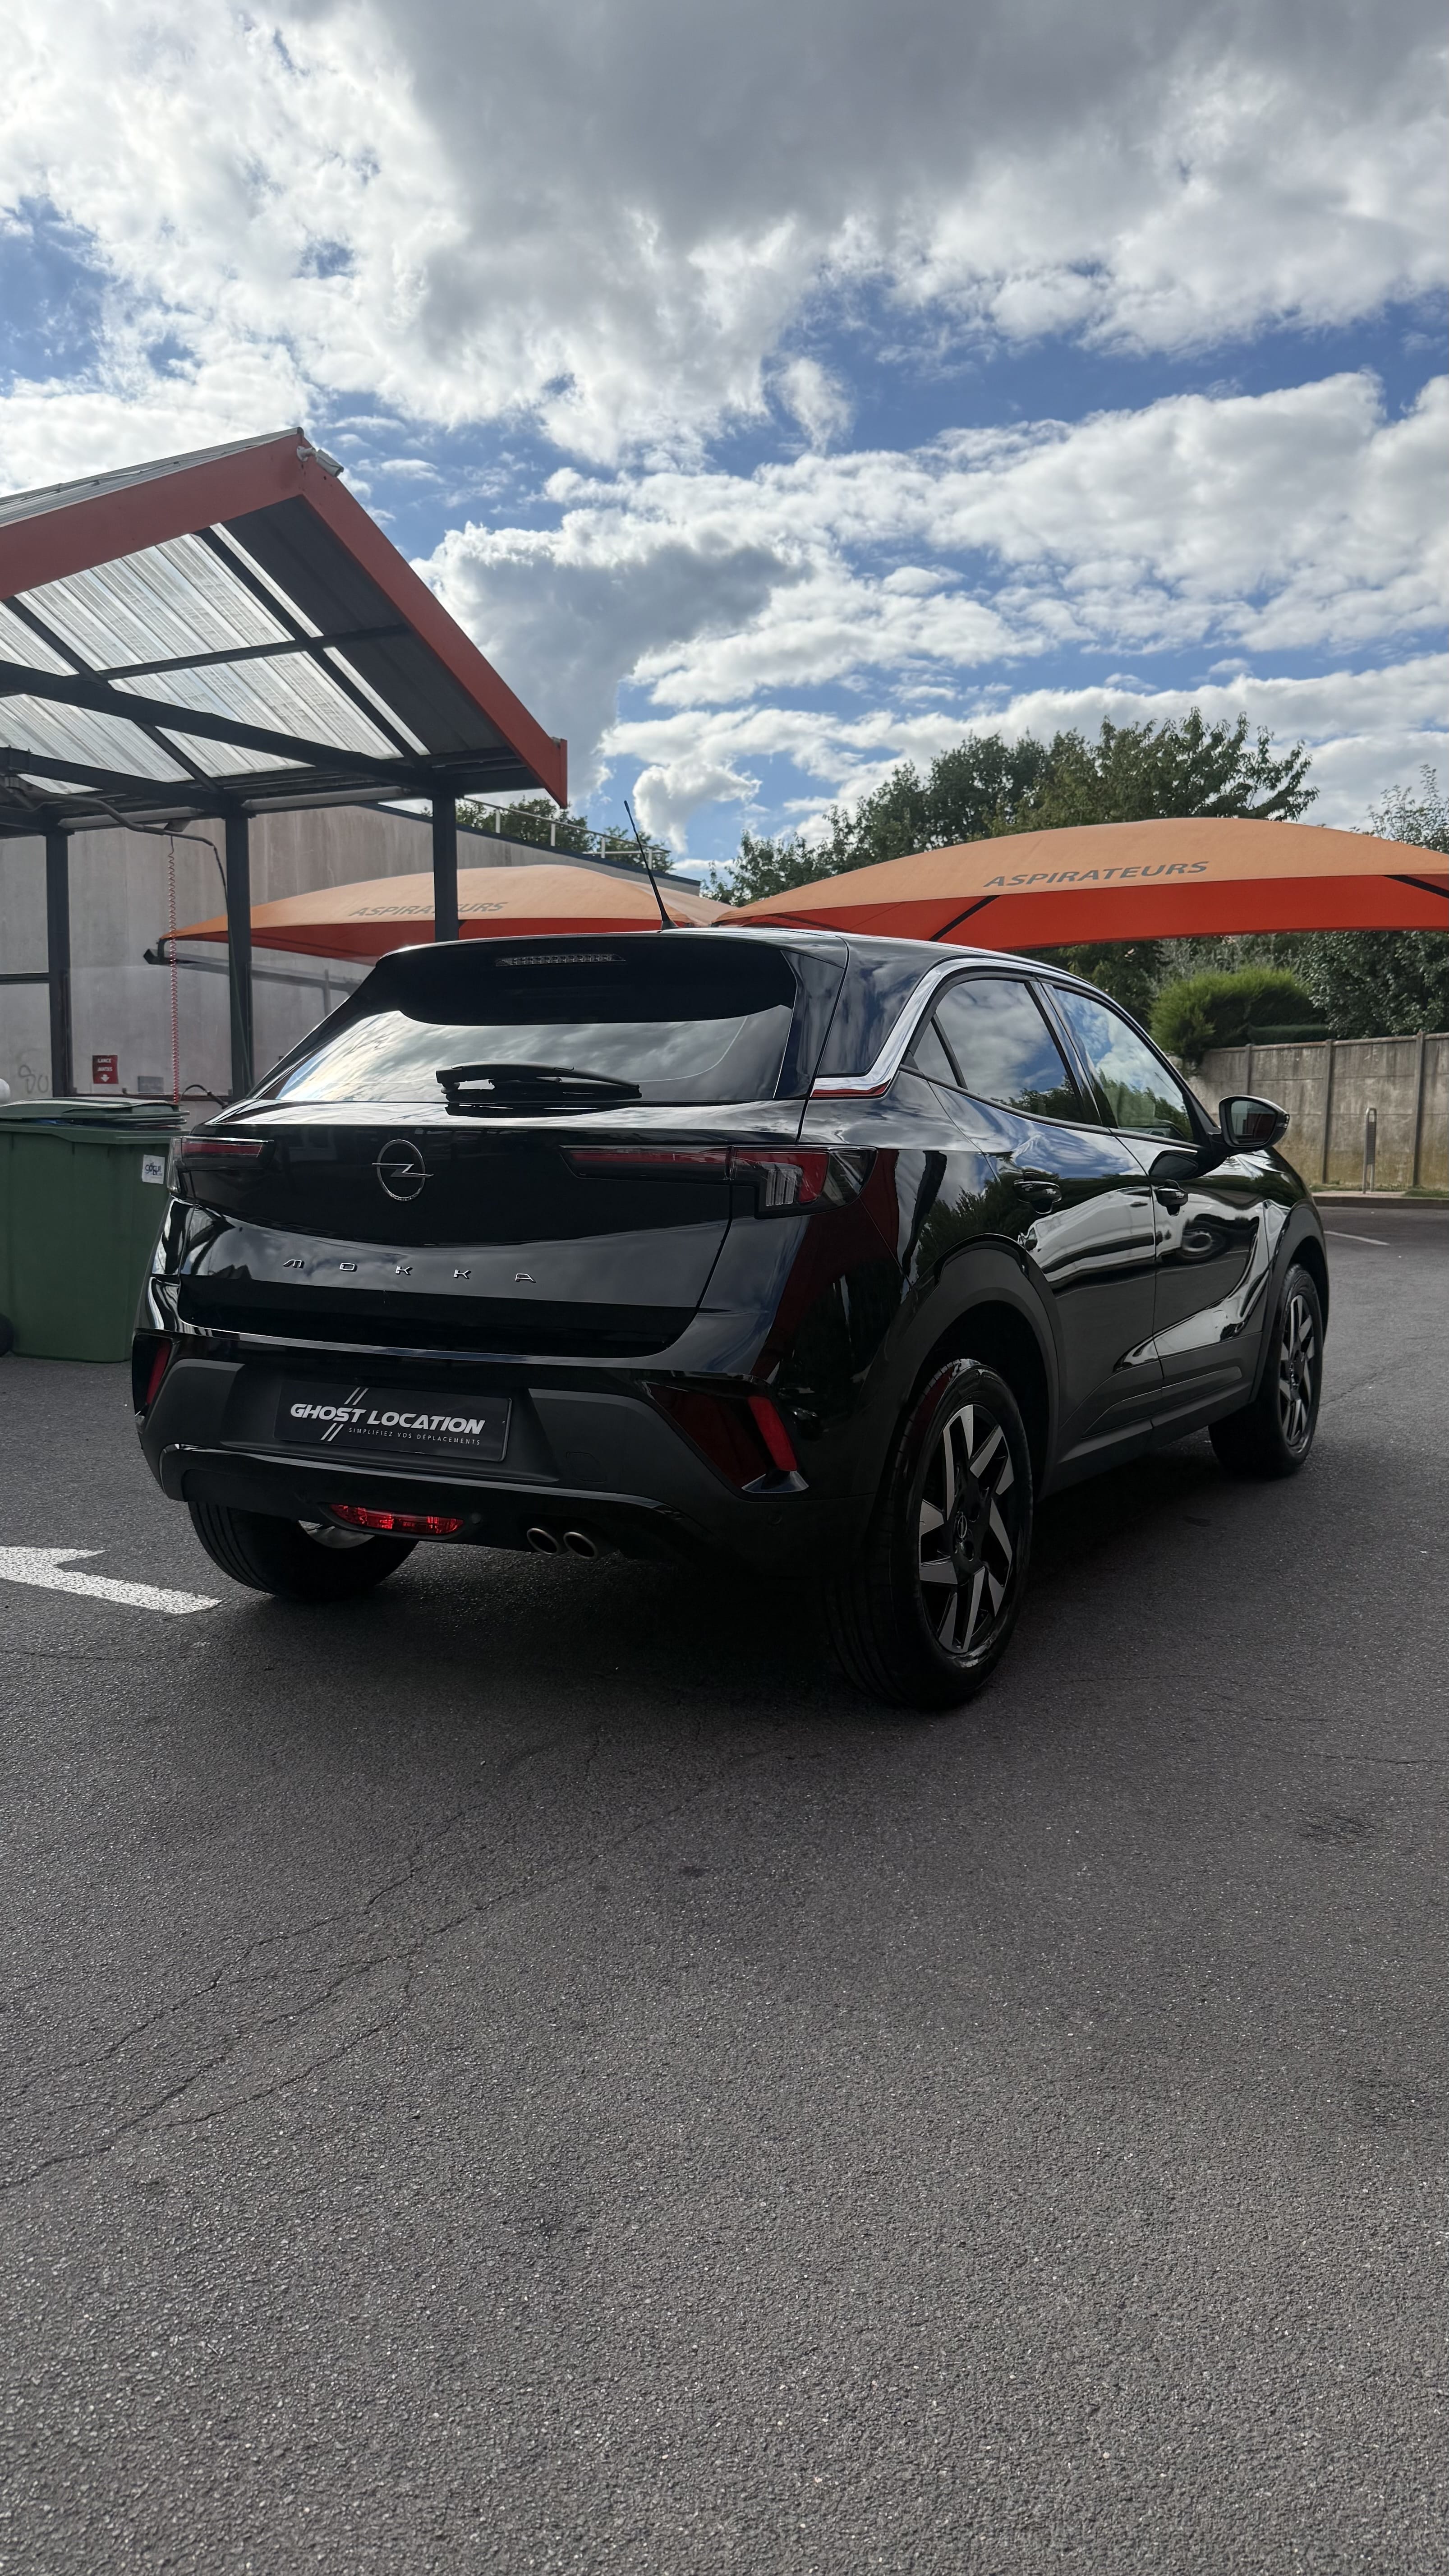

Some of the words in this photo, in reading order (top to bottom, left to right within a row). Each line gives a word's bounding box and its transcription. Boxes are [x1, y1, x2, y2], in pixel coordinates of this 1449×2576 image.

[983, 861, 1209, 887] ASPIRATEURS
[348, 902, 508, 916] ASPIRAURS
[283, 1259, 536, 1283] MOKKA
[290, 1403, 366, 1422] GHOST
[367, 1410, 485, 1434] LOCATION
[349, 1427, 393, 1436] SIMPLIFIEZ
[417, 1434, 480, 1445] DÉPLACEMENTS
